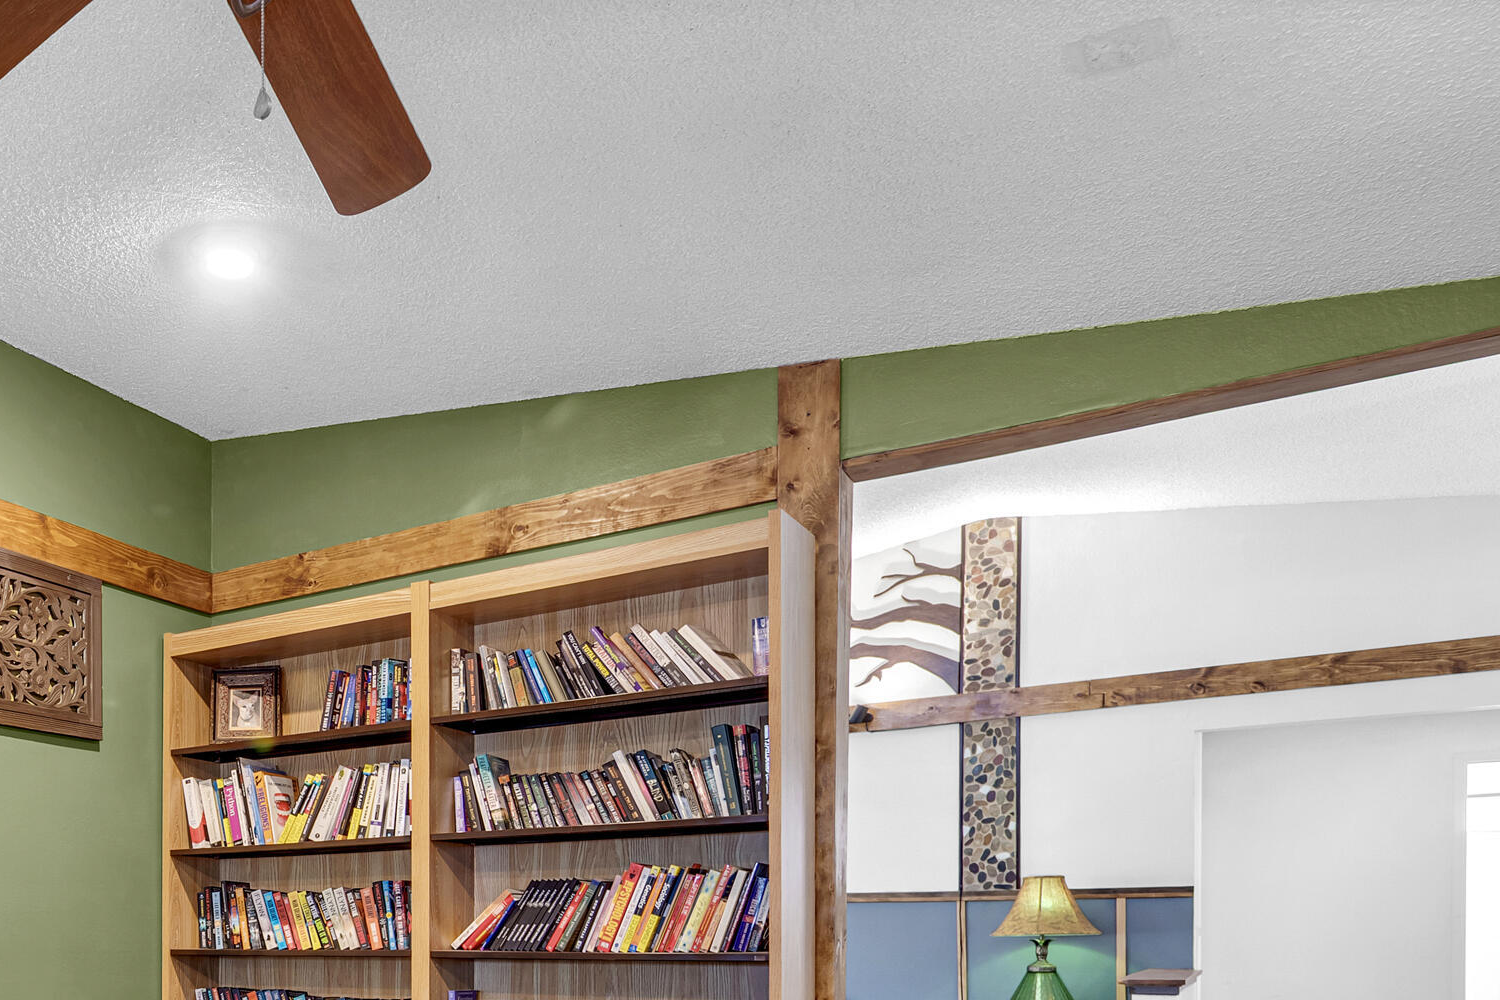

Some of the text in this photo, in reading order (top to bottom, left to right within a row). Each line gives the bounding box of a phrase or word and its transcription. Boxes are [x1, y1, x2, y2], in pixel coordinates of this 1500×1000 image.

[567, 634, 576, 645] YOU
[581, 643, 610, 677] TOTAL POWER
[225, 787, 237, 816] Python
[646, 778, 664, 803] BLIND
[258, 792, 269, 827] RELIGIONS
[604, 885, 632, 937] PSYCHOLOGY
[637, 884, 653, 910] Genetics
[654, 882, 671, 911] Sociology
